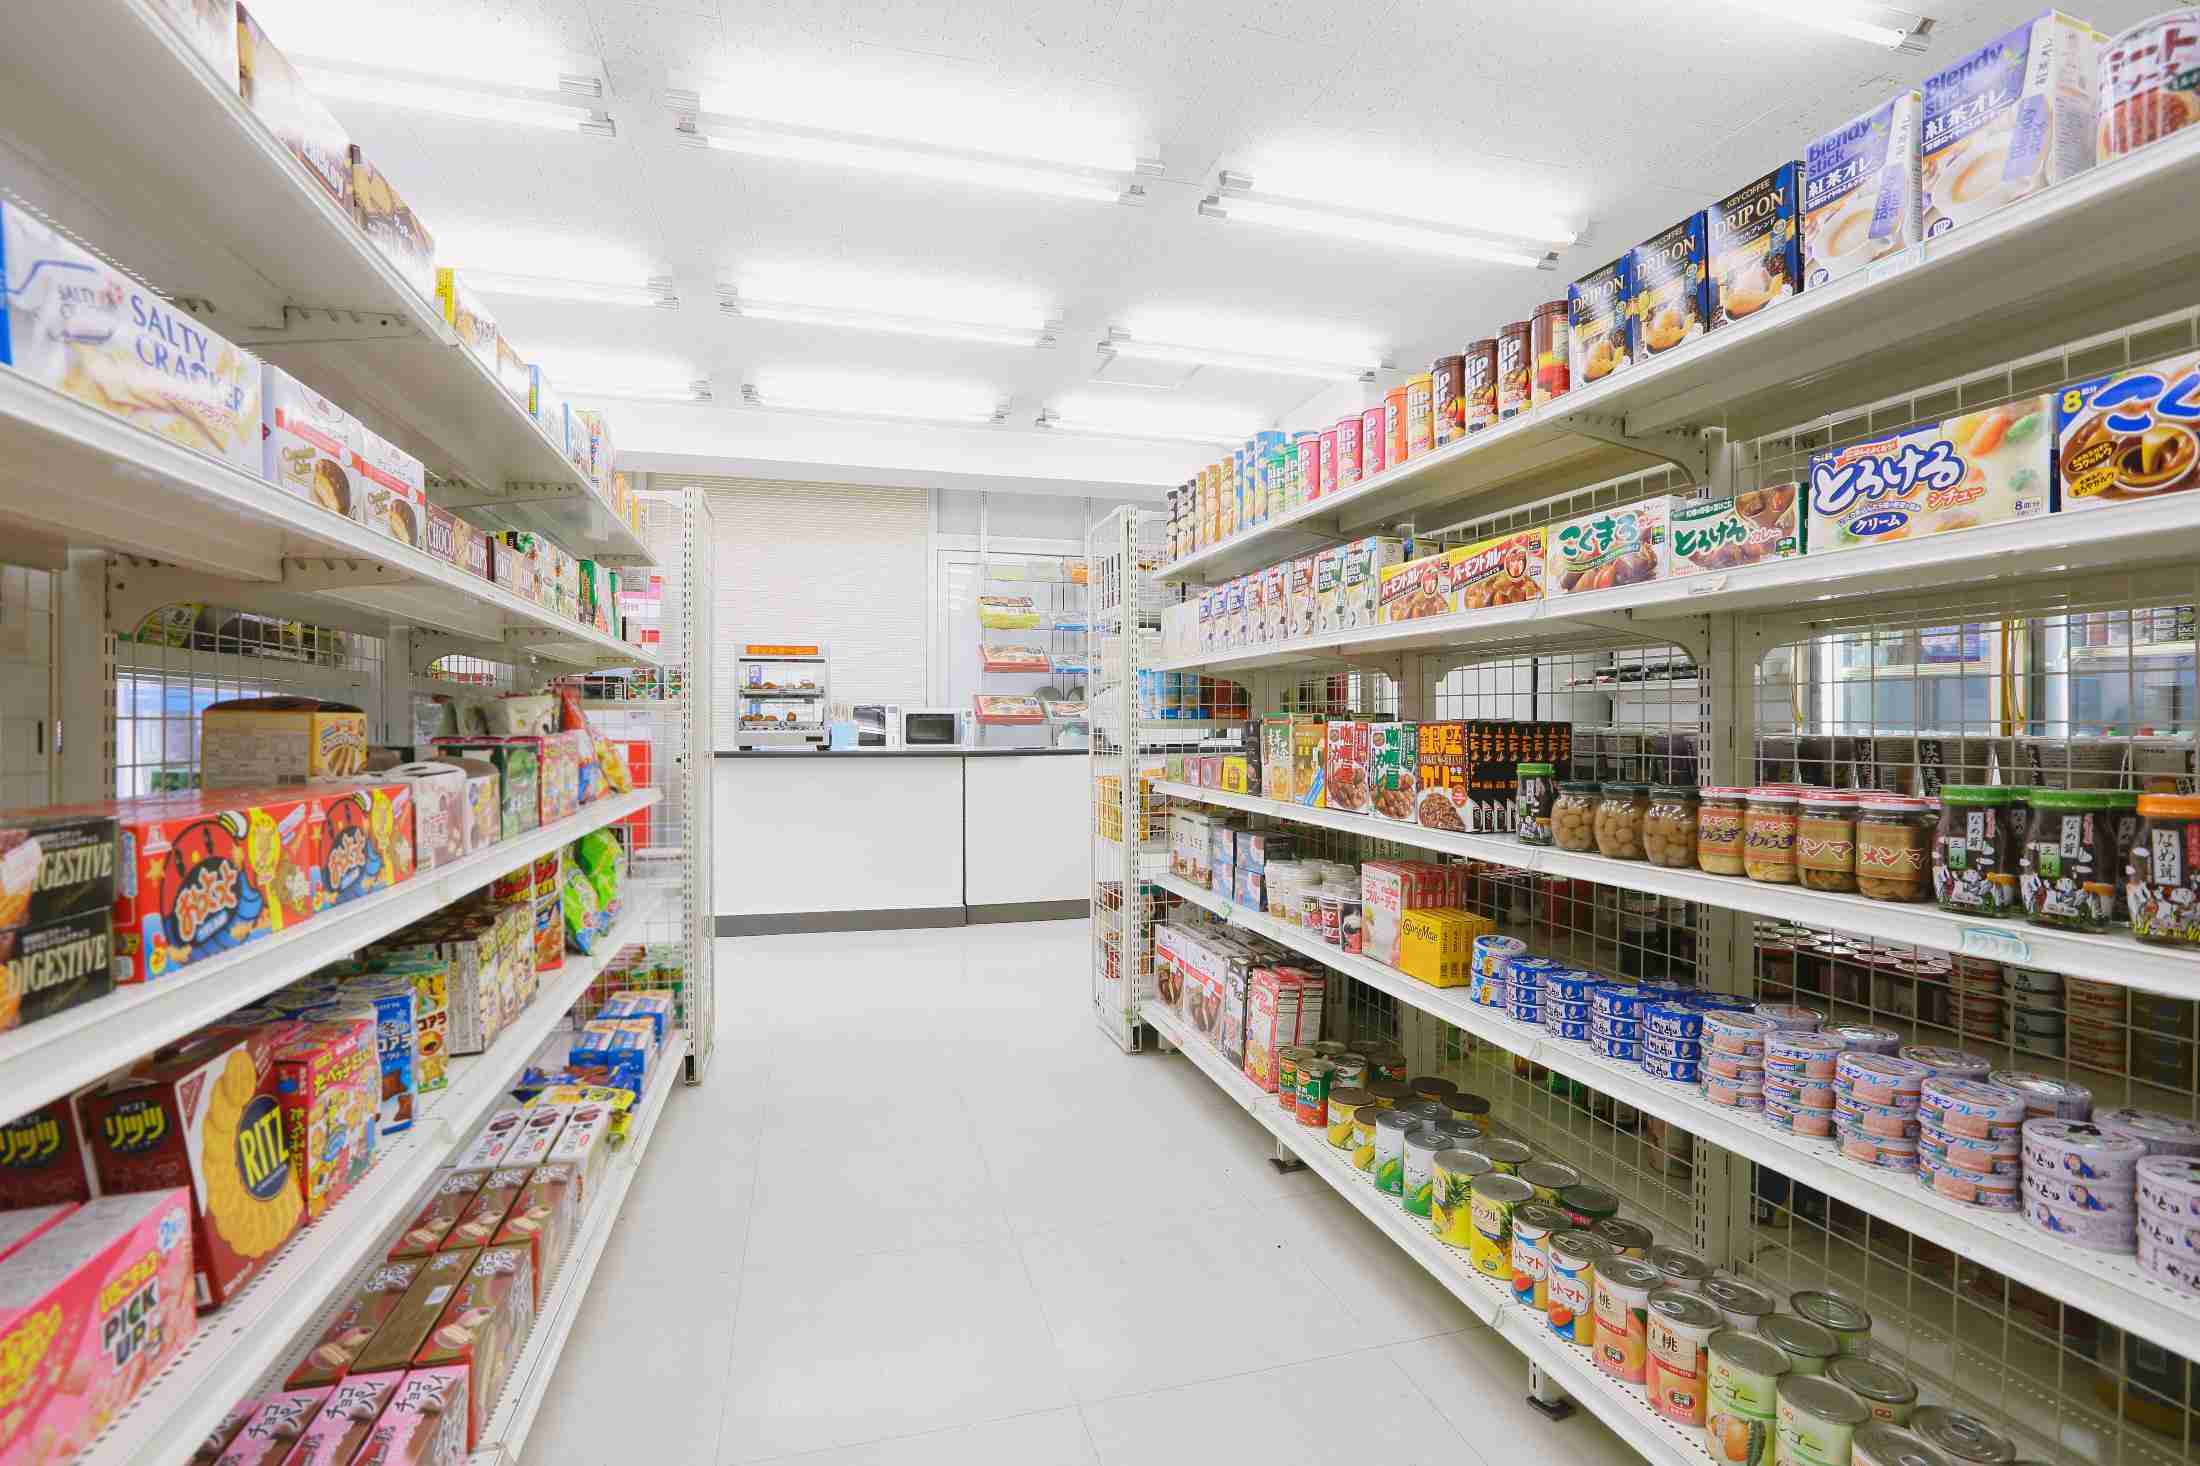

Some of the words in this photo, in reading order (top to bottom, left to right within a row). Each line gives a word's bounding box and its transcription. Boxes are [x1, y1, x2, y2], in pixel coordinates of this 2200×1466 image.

[1808, 158, 1871, 197] 紅茶オレ
[1757, 188, 1784, 214] ON
[1672, 235, 1696, 258] ON
[1605, 274, 1625, 293] ON
[130, 294, 208, 362] SALTY
[2088, 368, 2200, 432] こく
[1815, 443, 1965, 514] とろける
[1928, 487, 1985, 507] シチュー
[1559, 512, 1638, 557] こくまろ
[1675, 518, 1747, 557] とろける
[1856, 516, 1900, 534] クリーム
[1420, 725, 1463, 754] 銀座
[2064, 815, 2081, 857] なめ茸
[33, 842, 112, 892] IGESTIVE
[2157, 831, 2179, 884] なめ茸
[8, 935, 108, 996] DIGESTIVE
[416, 1011, 447, 1031] コアラ
[105, 1106, 166, 1148] リッツ
[240, 1105, 289, 1188] RITZ
[104, 1281, 157, 1350] PICK
